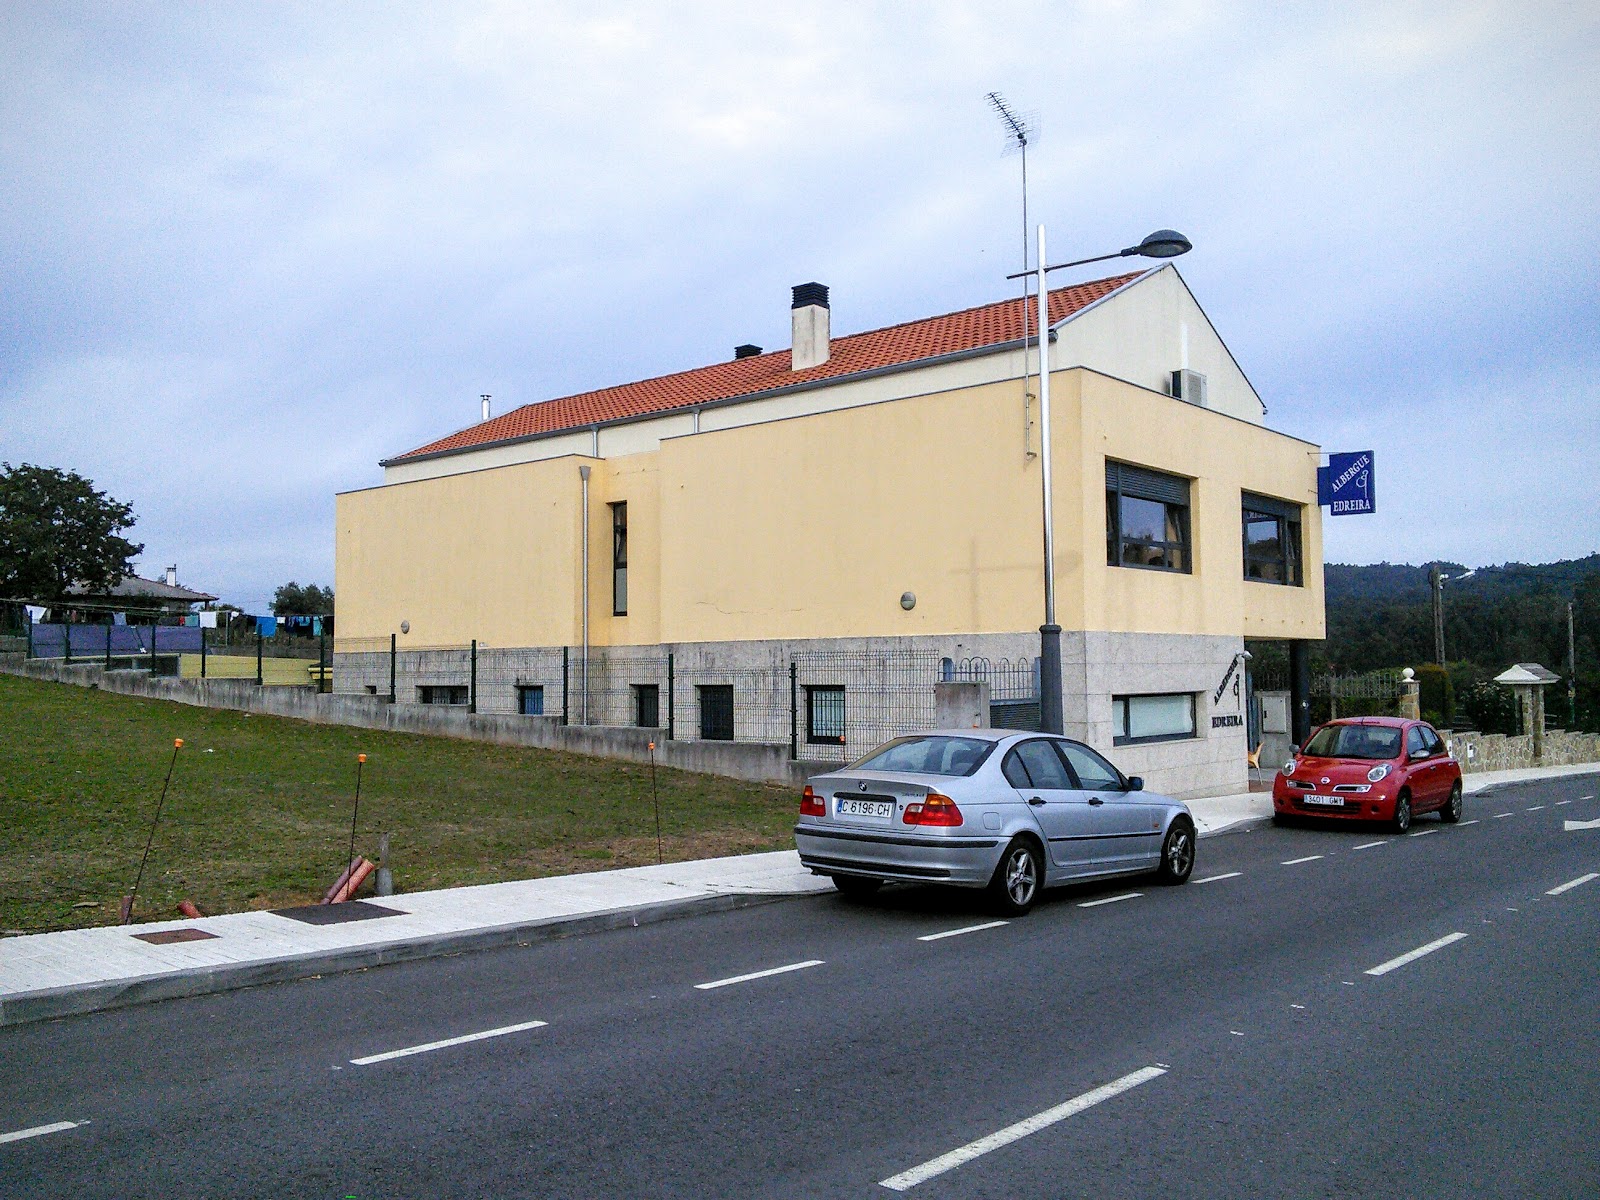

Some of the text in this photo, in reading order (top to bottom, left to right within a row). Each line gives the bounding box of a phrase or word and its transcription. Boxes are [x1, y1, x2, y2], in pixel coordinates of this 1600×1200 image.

[1331, 454, 1370, 493] ALBERGUE
[1333, 499, 1371, 512] EDREIRA
[1211, 715, 1243, 728] EDREIRA
[850, 801, 875, 815] 6196
[877, 803, 891, 817] CH
